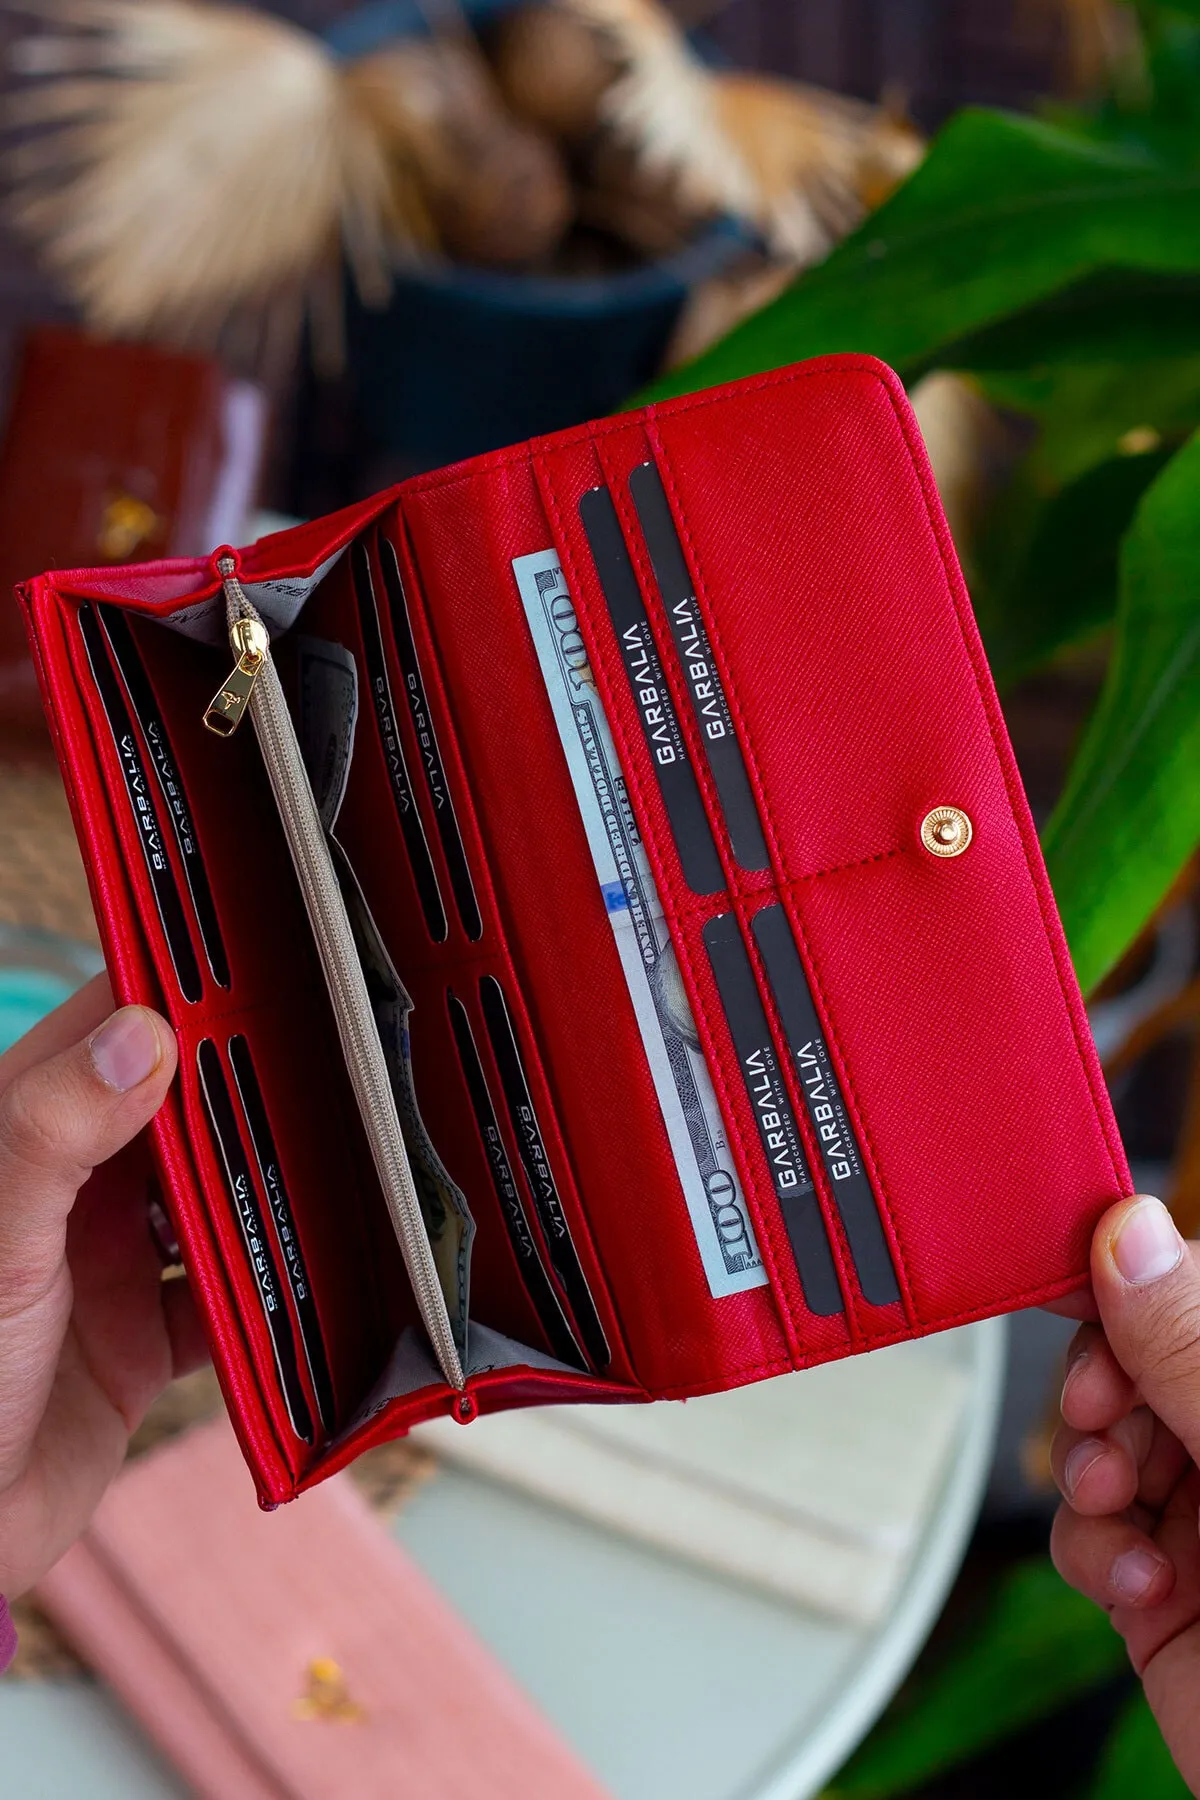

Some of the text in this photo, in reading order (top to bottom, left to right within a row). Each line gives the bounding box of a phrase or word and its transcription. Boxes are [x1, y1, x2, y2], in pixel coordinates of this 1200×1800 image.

[550, 594, 597, 691] 100
[623, 624, 675, 764] GARBALIA
[640, 620, 685, 760] HANDCRAFTED WITH LOVE
[673, 599, 725, 739] GARBALIA
[690, 596, 734, 734] HANDCRAFTED WITH LOVE
[121, 736, 162, 869] GARBALIA
[148, 723, 192, 854] GARBALIA
[377, 677, 409, 811] GARBALIA
[408, 673, 444, 808] GARBALIA
[521, 1106, 565, 1237] GARBALIA
[746, 1050, 797, 1189] GARBALIA
[763, 1046, 807, 1183] HANDCRAFTED WITH LOVE
[797, 1042, 851, 1180] GARBALIA
[814, 1038, 860, 1175] HANDCRAFTED WITH LOVE
[236, 1176, 274, 1311] GARBALIA
[268, 1166, 305, 1299] GARBALIA
[488, 1127, 532, 1256] GARBALIA
[706, 1169, 753, 1260] 100
